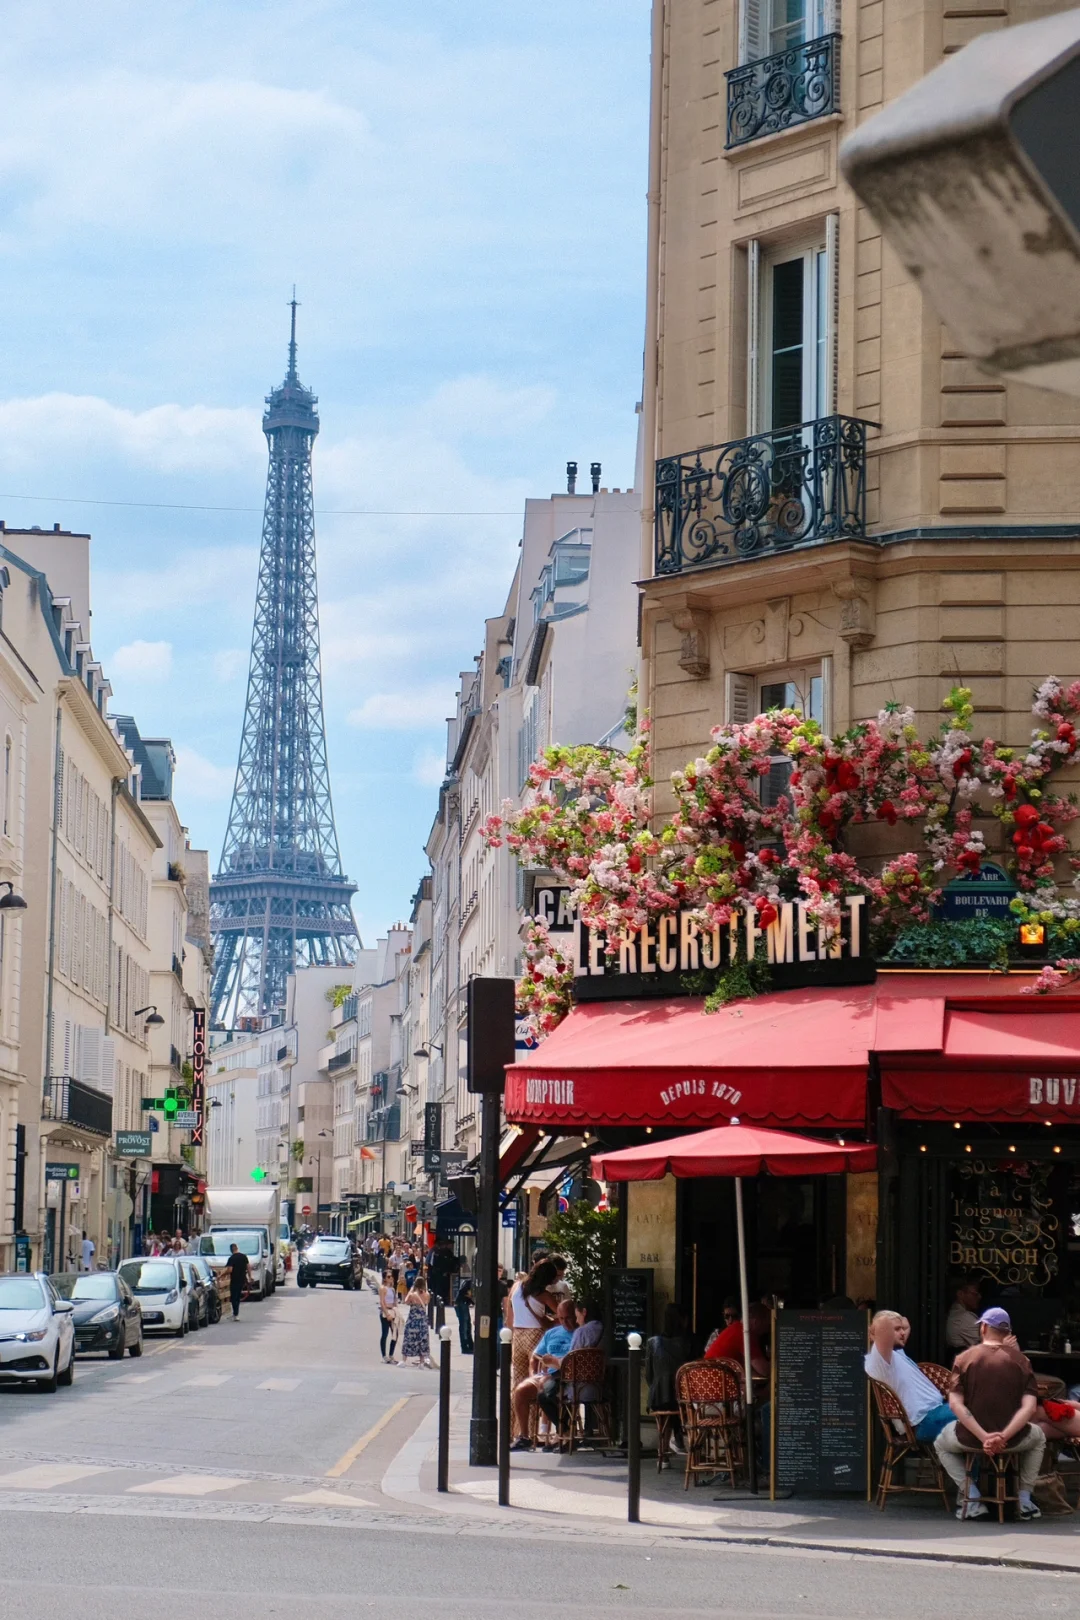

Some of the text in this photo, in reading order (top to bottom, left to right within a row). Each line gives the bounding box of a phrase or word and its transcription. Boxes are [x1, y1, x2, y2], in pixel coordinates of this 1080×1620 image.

[955, 895, 1009, 906] BOULEVARD
[975, 907, 989, 917] DE
[573, 919, 605, 977] LE
[660, 1079, 742, 1106] DEPUIS 1870
[1029, 1077, 1080, 1105] BUV
[118, 1137, 151, 1145] PROVOST
[949, 1240, 1039, 1266] BRUNCH
